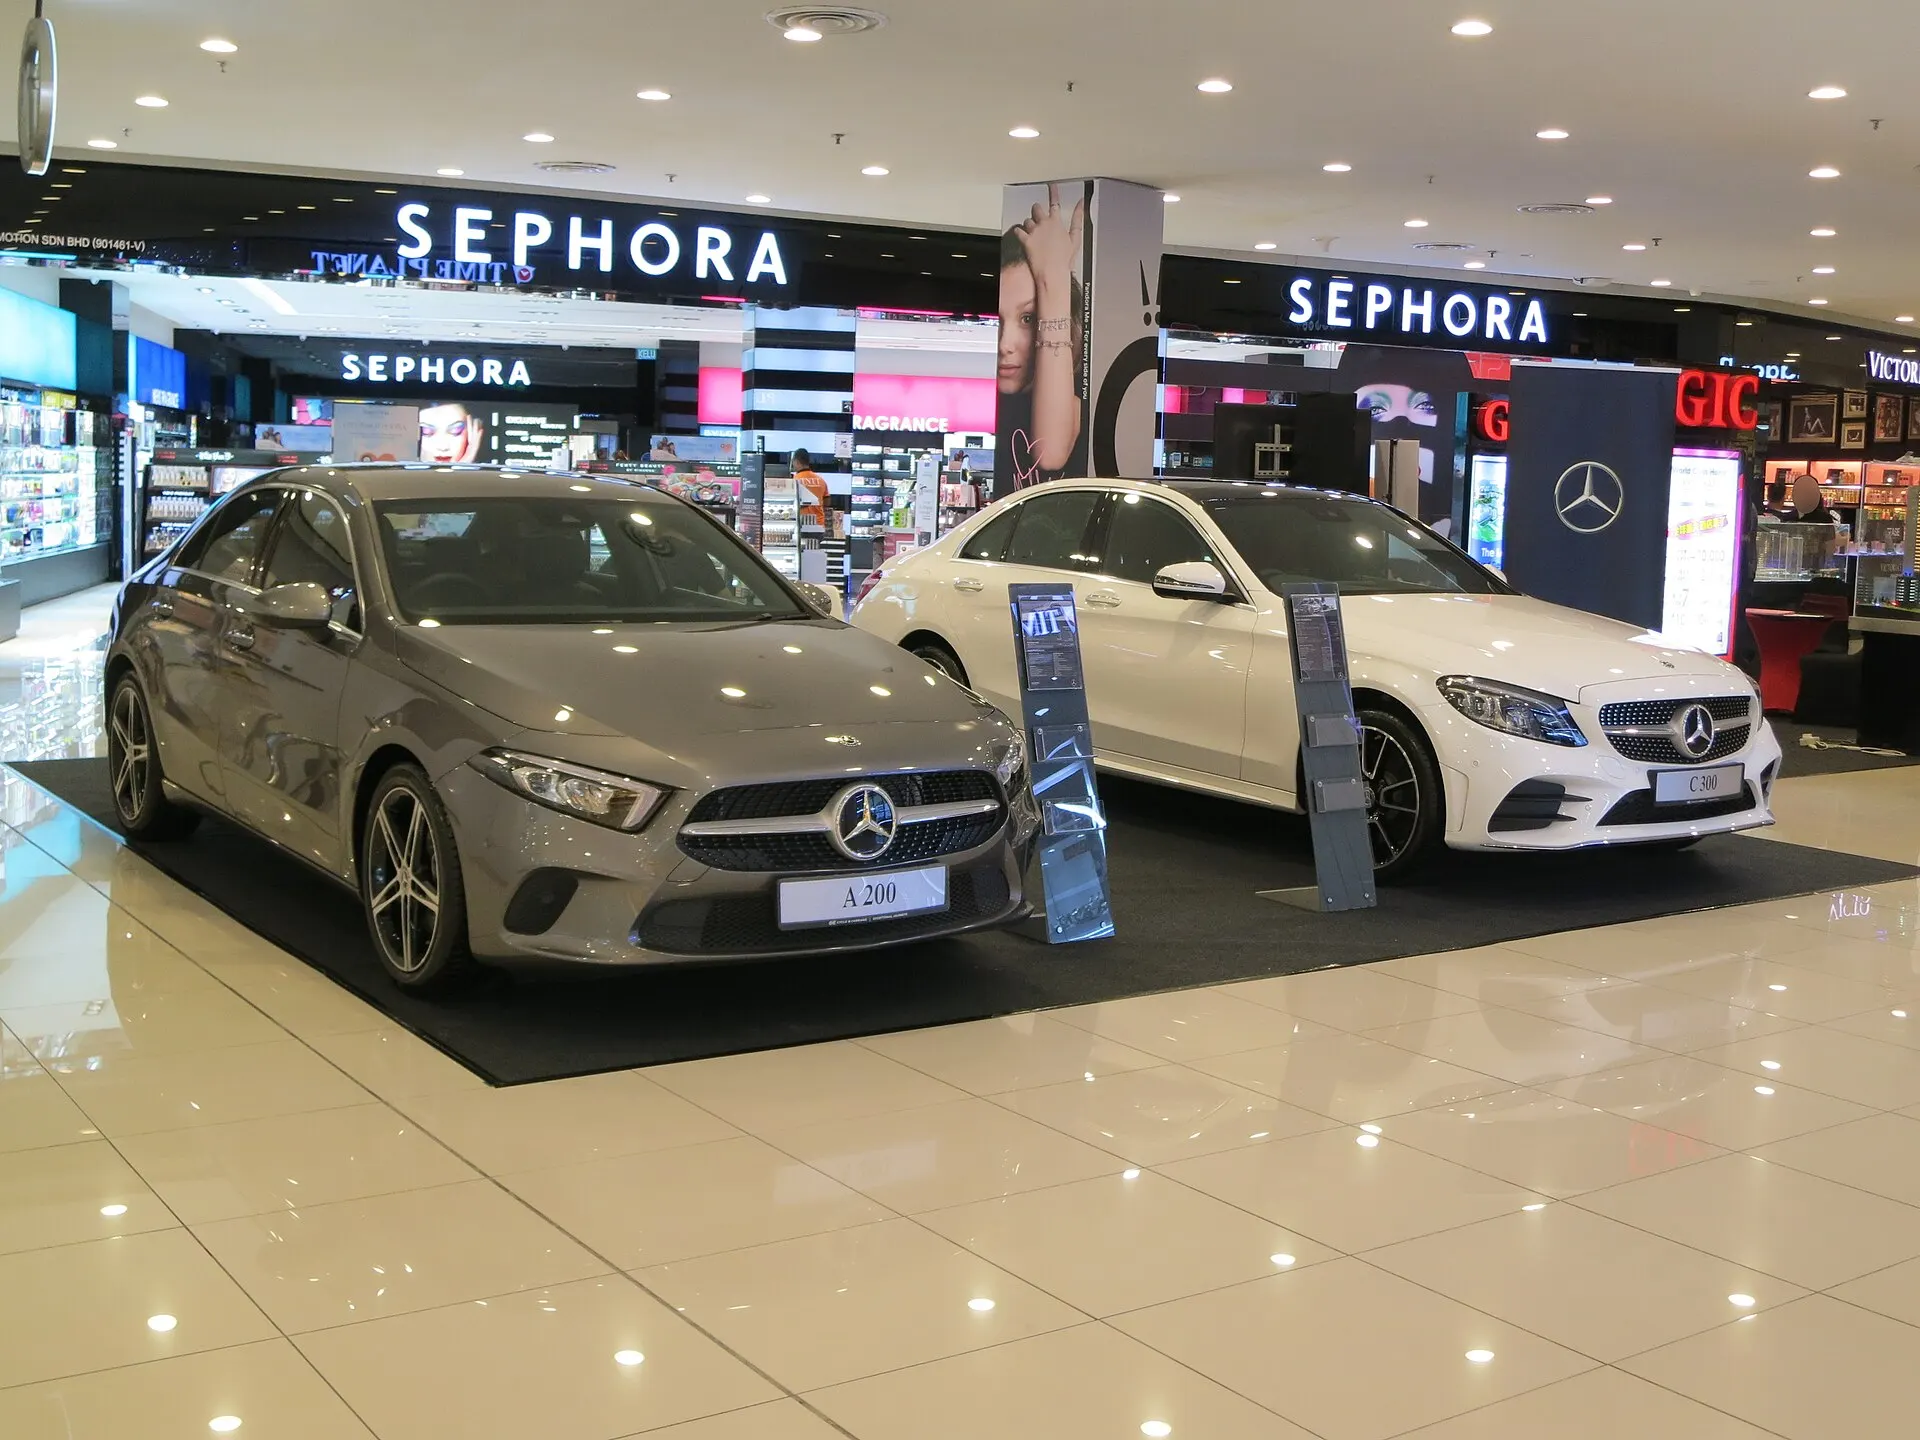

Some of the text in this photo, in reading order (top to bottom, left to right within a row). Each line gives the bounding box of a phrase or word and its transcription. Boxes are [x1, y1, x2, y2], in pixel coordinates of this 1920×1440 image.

[41, 235, 65, 246] SDN
[67, 236, 91, 248] BHD
[92, 237, 146, 252] (901461-V)
[397, 203, 787, 286] SEPHORA
[1288, 279, 1550, 344] SEPHORA
[341, 354, 532, 387] SEPHORA
[1675, 370, 1759, 430] GIC
[1689, 774, 1718, 792] C 300
[844, 882, 896, 908] A 200
